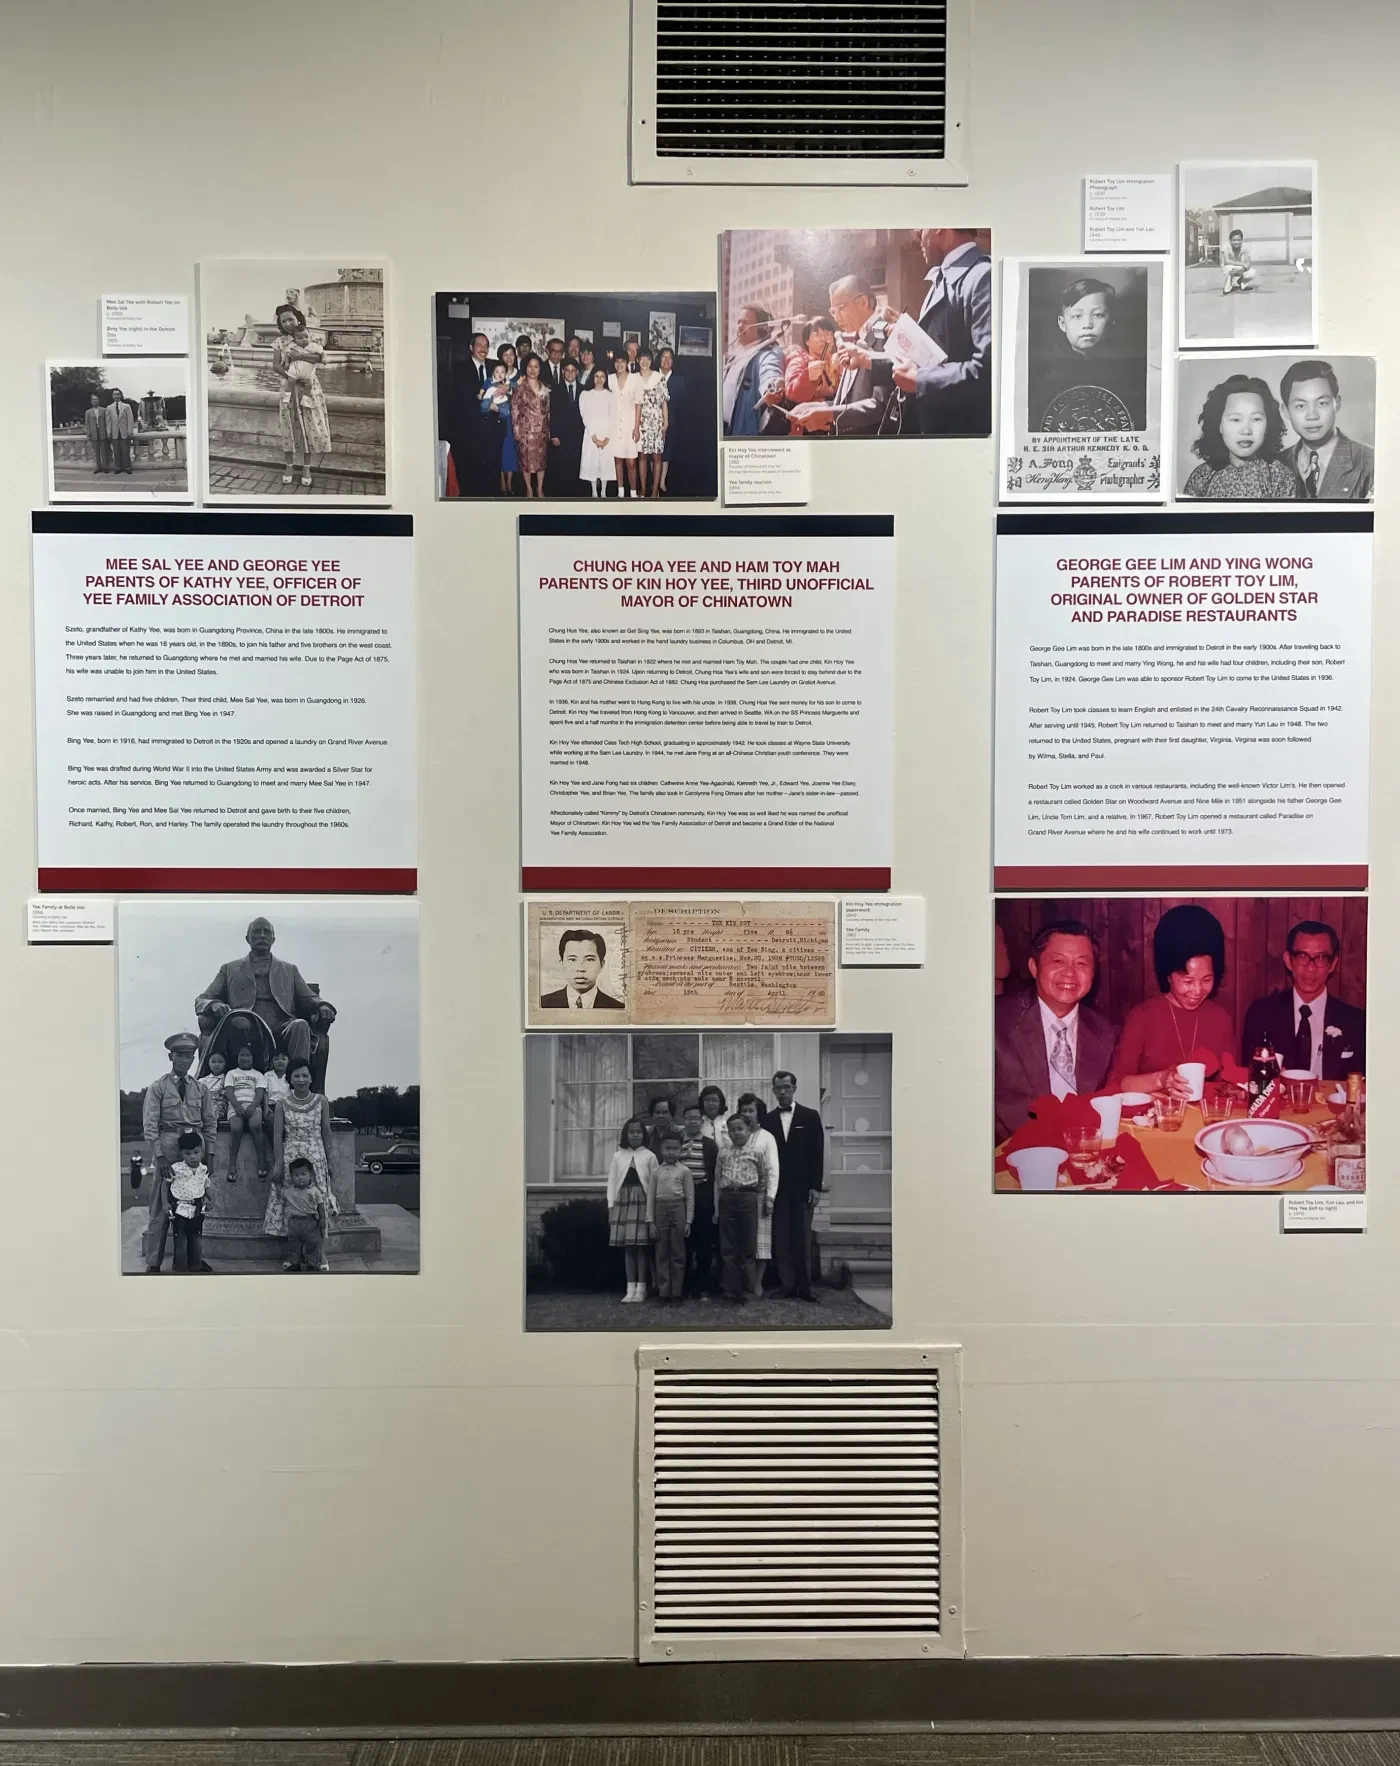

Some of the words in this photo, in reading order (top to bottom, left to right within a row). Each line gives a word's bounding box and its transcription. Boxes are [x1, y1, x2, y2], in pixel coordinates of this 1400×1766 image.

[106, 558, 137, 570] MEE
[141, 558, 171, 570] SAL
[174, 559, 203, 570] YEE
[207, 559, 239, 571] AND
[242, 559, 307, 571] GEORGE
[311, 560, 340, 571] YEE
[573, 560, 627, 572] CHUNG
[631, 560, 663, 572] HOA
[667, 561, 696, 572] YEE
[700, 561, 731, 572] AND
[735, 561, 768, 572] HAM
[772, 561, 802, 573] TOY
[806, 561, 839, 572] MAH
[1056, 558, 1121, 571] GEORGE
[1125, 558, 1156, 570] GEE
[1160, 558, 1185, 570] LIM
[1189, 558, 1221, 570] AND
[1225, 557, 1260, 569] YING
[1264, 557, 1312, 569] WONG
[85, 575, 155, 588] PARENTS
[158, 576, 179, 588] OF
[183, 576, 232, 588] KATHY
[236, 577, 268, 591] YEE,
[273, 577, 336, 589] OFFICER
[340, 577, 361, 589] OF
[539, 577, 608, 589] PARENTS
[612, 578, 632, 589] OF
[636, 578, 661, 589] KIN
[665, 578, 696, 590] HOY
[700, 578, 733, 592] YEE,
[737, 578, 782, 590] THIRD
[785, 578, 873, 590] UNOFFICIAL
[1071, 575, 1140, 588] PARENTS
[1144, 575, 1164, 587] OF
[1168, 575, 1231, 587] ROBERT
[1234, 575, 1265, 587] TOY
[1269, 575, 1297, 588] LIM,
[83, 593, 112, 604] YEE
[116, 593, 168, 605] FAMILY
[172, 593, 272, 606] ASSOCIATION
[276, 594, 296, 606] OF
[300, 594, 364, 607] DETROIT
[621, 595, 674, 607] MAYOR
[678, 595, 698, 607] OF
[702, 595, 792, 607] CHINATOWN
[1048, 593, 1122, 605] ORIGINAL
[1126, 593, 1182, 605] OWNER
[1186, 592, 1207, 604] OF
[1211, 592, 1275, 604] GOLDEN
[1278, 591, 1318, 604] STAR
[1071, 611, 1103, 622] AND
[1107, 610, 1182, 622] PARADISE
[1186, 609, 1297, 622] RESTAURANTS
[121, 709, 157, 718] Guangdong
[183, 710, 198, 718] Bing
